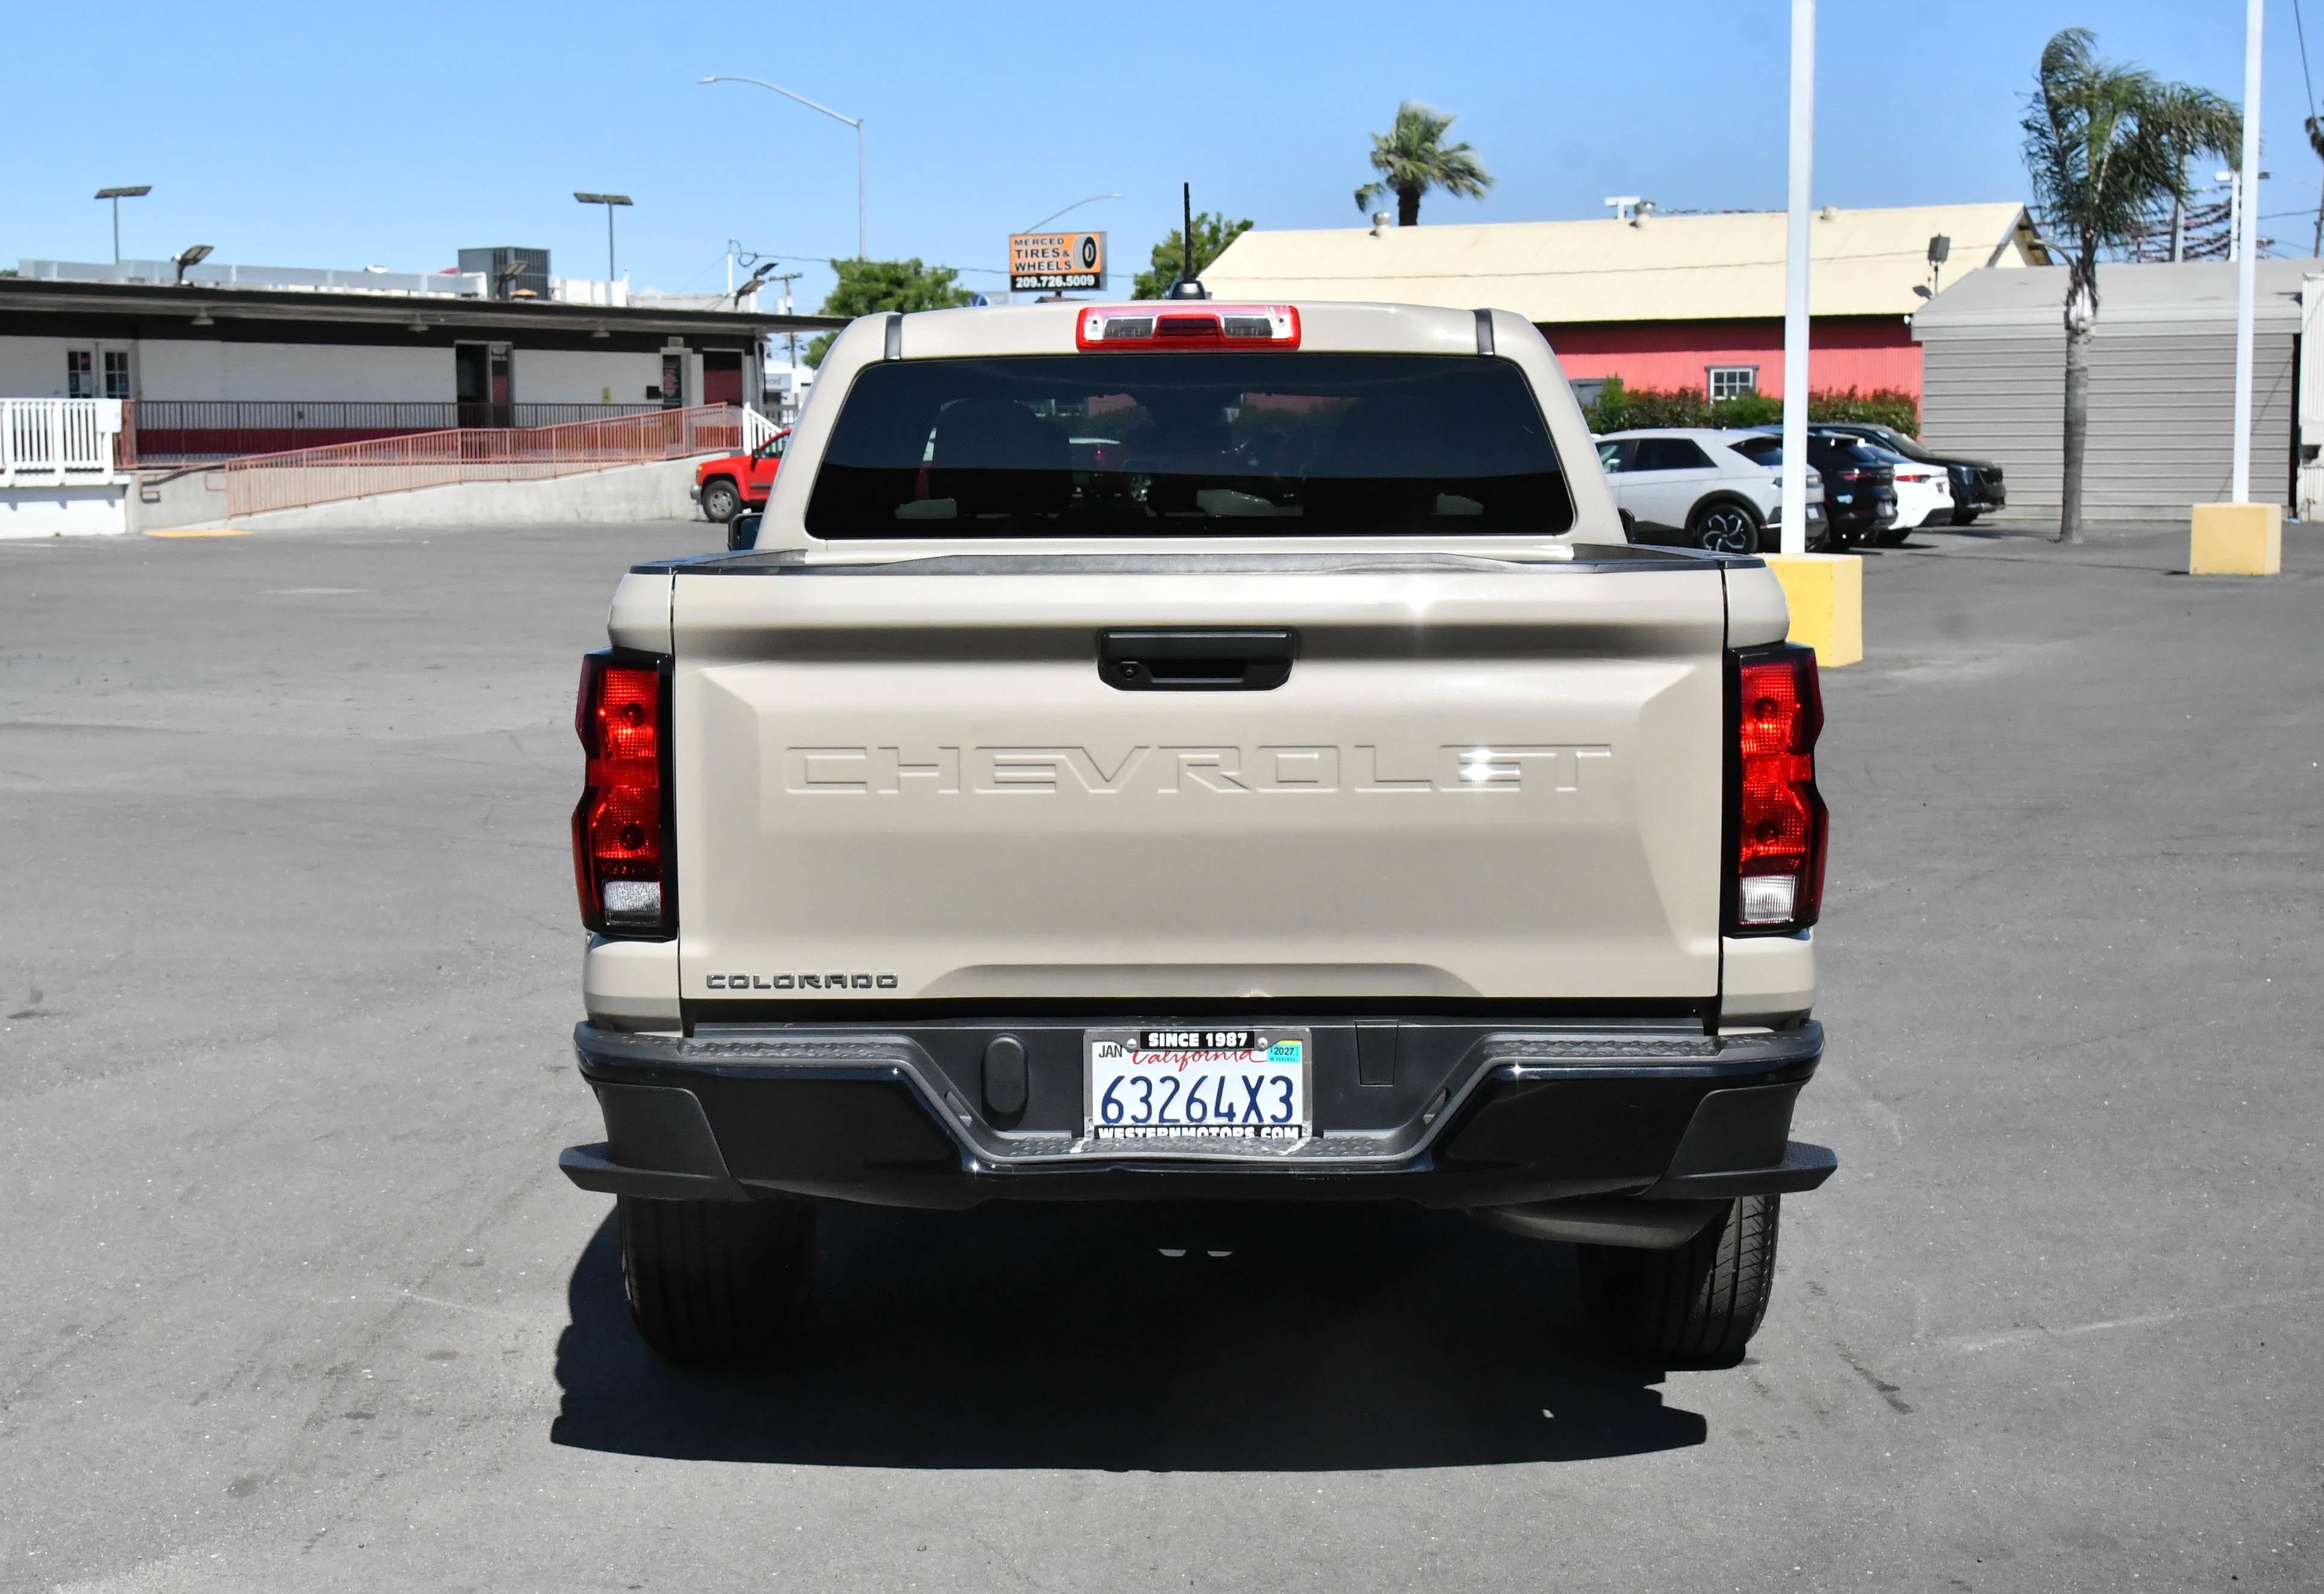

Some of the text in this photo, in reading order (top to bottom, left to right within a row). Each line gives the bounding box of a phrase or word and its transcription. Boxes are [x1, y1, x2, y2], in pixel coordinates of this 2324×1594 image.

[1015, 248, 1060, 258] TIRES
[1015, 260, 1072, 271] WHEELS
[1016, 275, 1095, 288] 209.726.5009
[786, 745, 1612, 793] CHEVROLET
[706, 972, 898, 989] COLORADO
[1149, 1032, 1248, 1047] SINCE 1987
[1098, 1044, 1295, 1072] JAN California 2027
[1101, 1075, 1293, 1124] 63264X3
